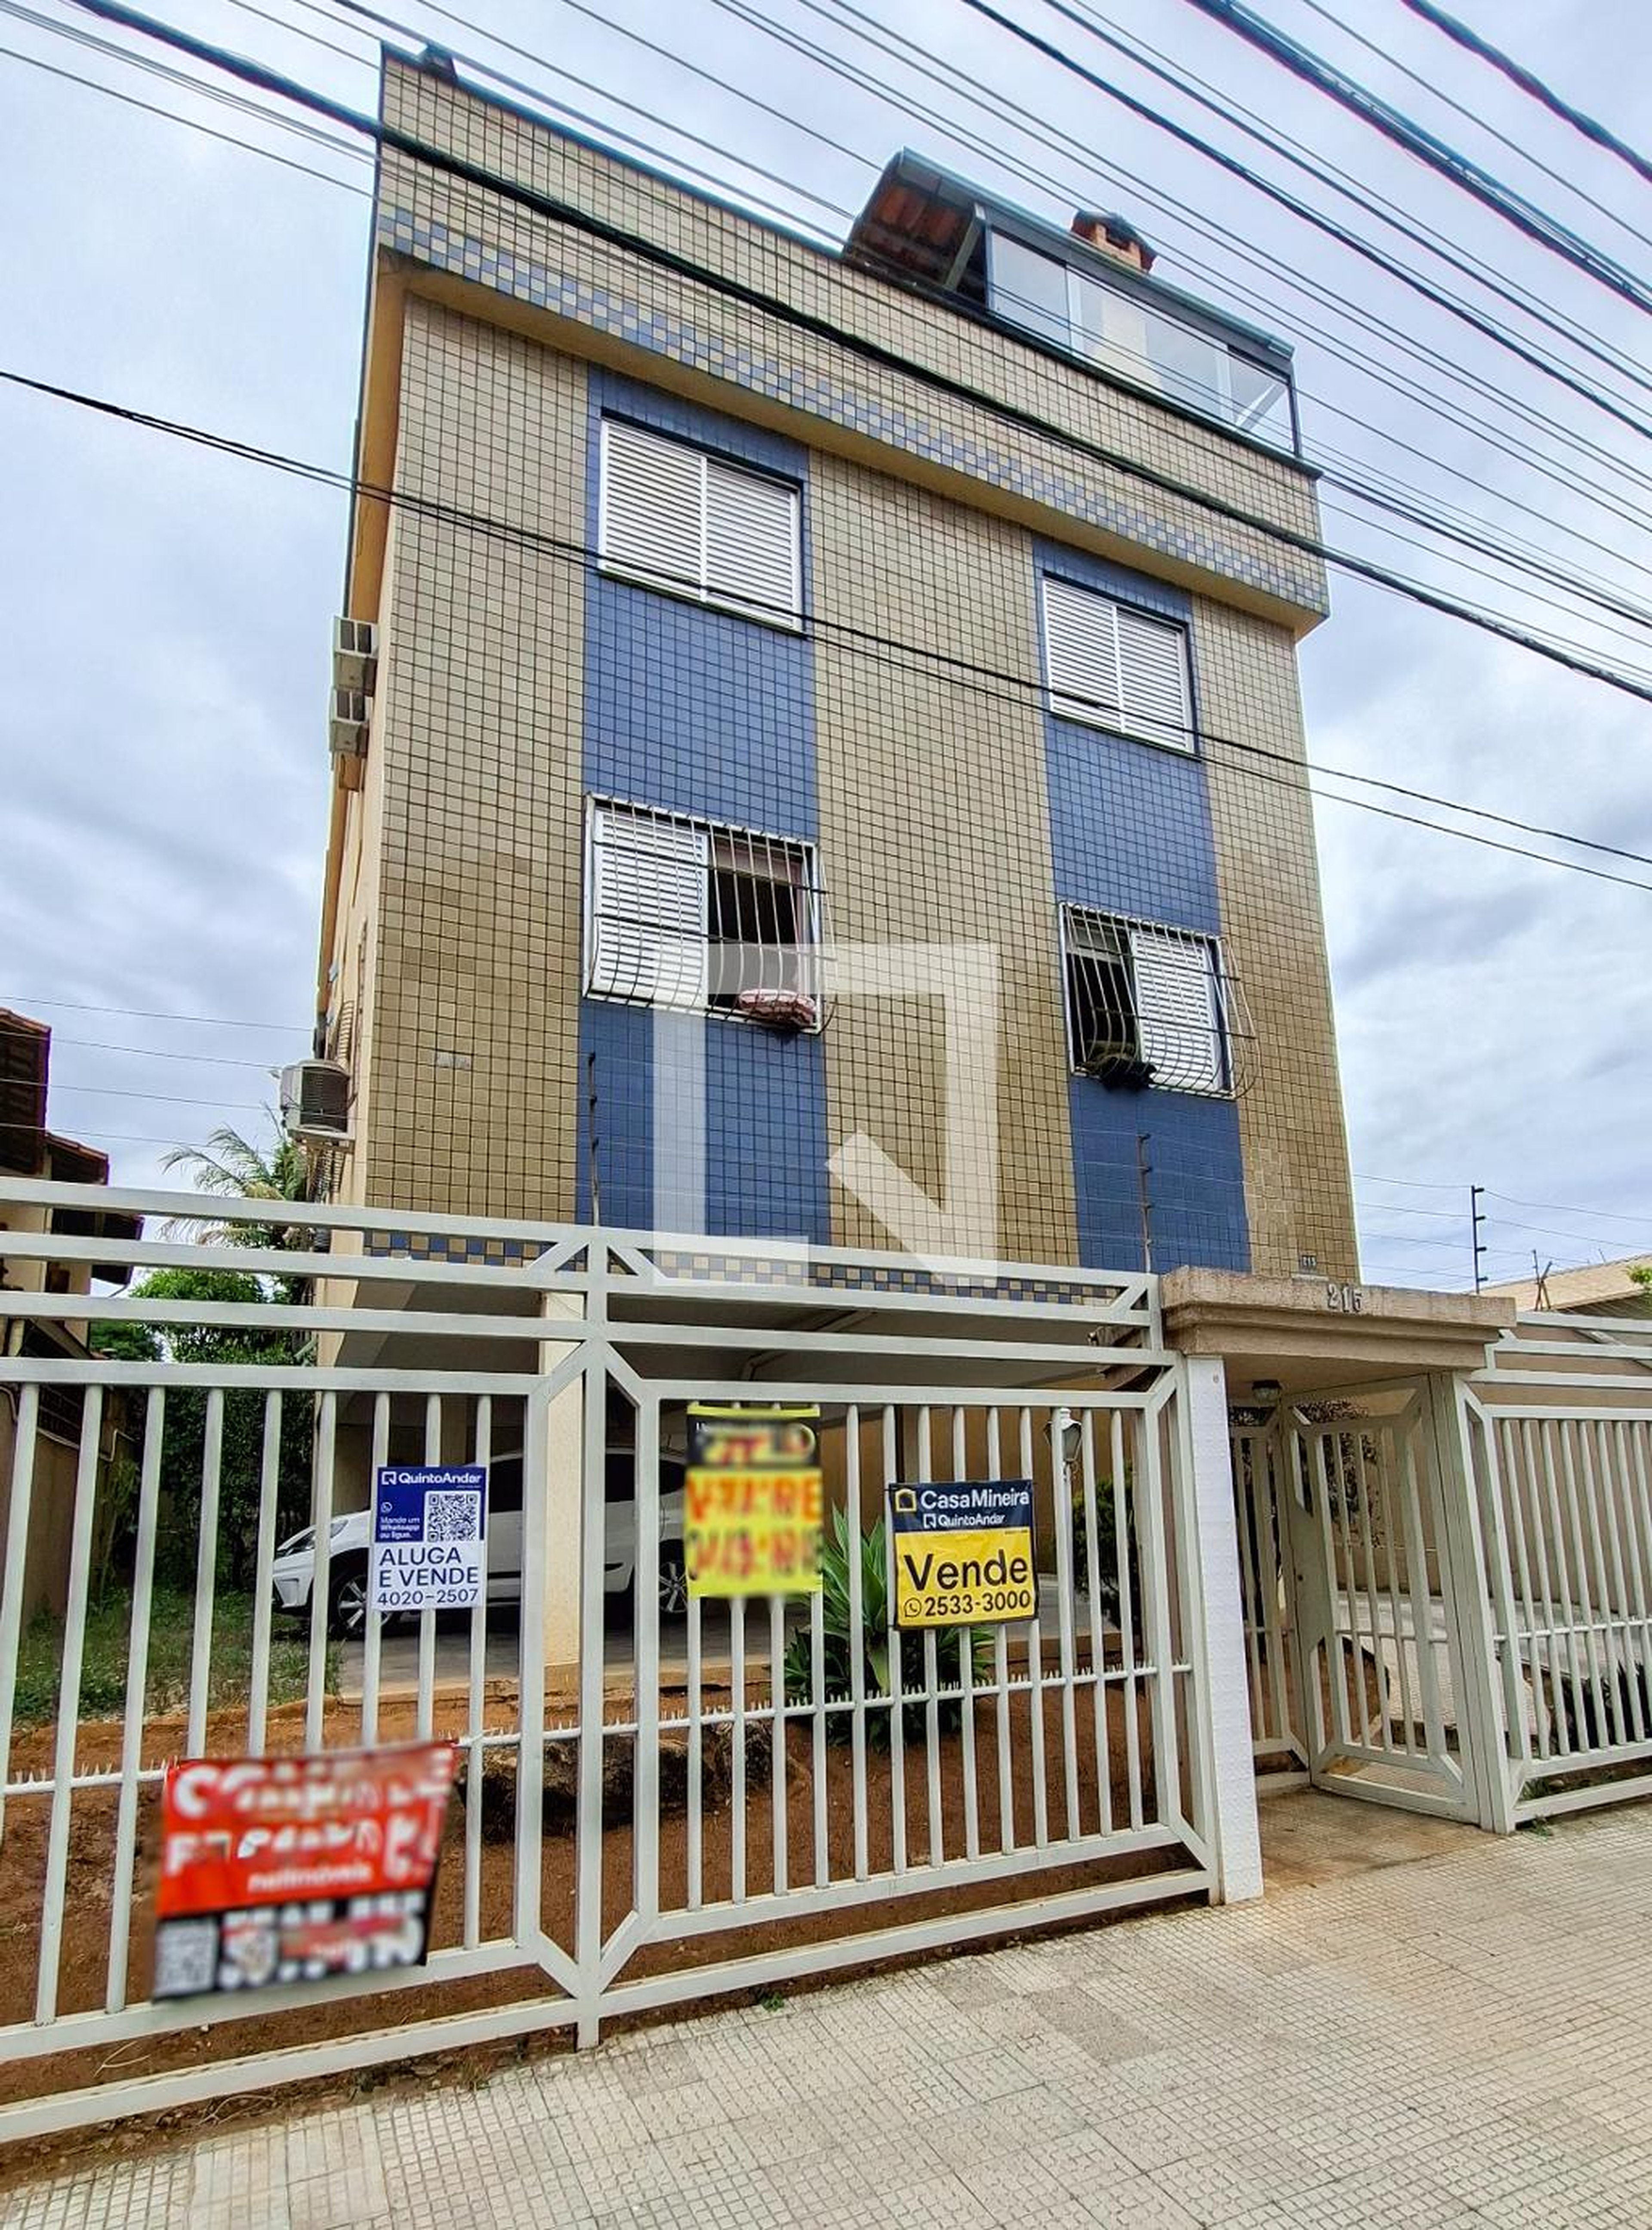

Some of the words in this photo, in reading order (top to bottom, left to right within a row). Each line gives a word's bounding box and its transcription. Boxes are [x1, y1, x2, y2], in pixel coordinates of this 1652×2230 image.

[1328, 1283, 1363, 1313] 215
[398, 1472, 482, 1484] QuintoAndar
[938, 1513, 1005, 1527] QuintoAndar
[379, 1547, 462, 1566] ALUGA
[379, 1570, 391, 1588] E
[399, 1567, 478, 1587] VENDE
[904, 1549, 1028, 1592] Vende
[378, 1588, 478, 1606] 4020-2507
[925, 1590, 1031, 1616] 2533-3000
